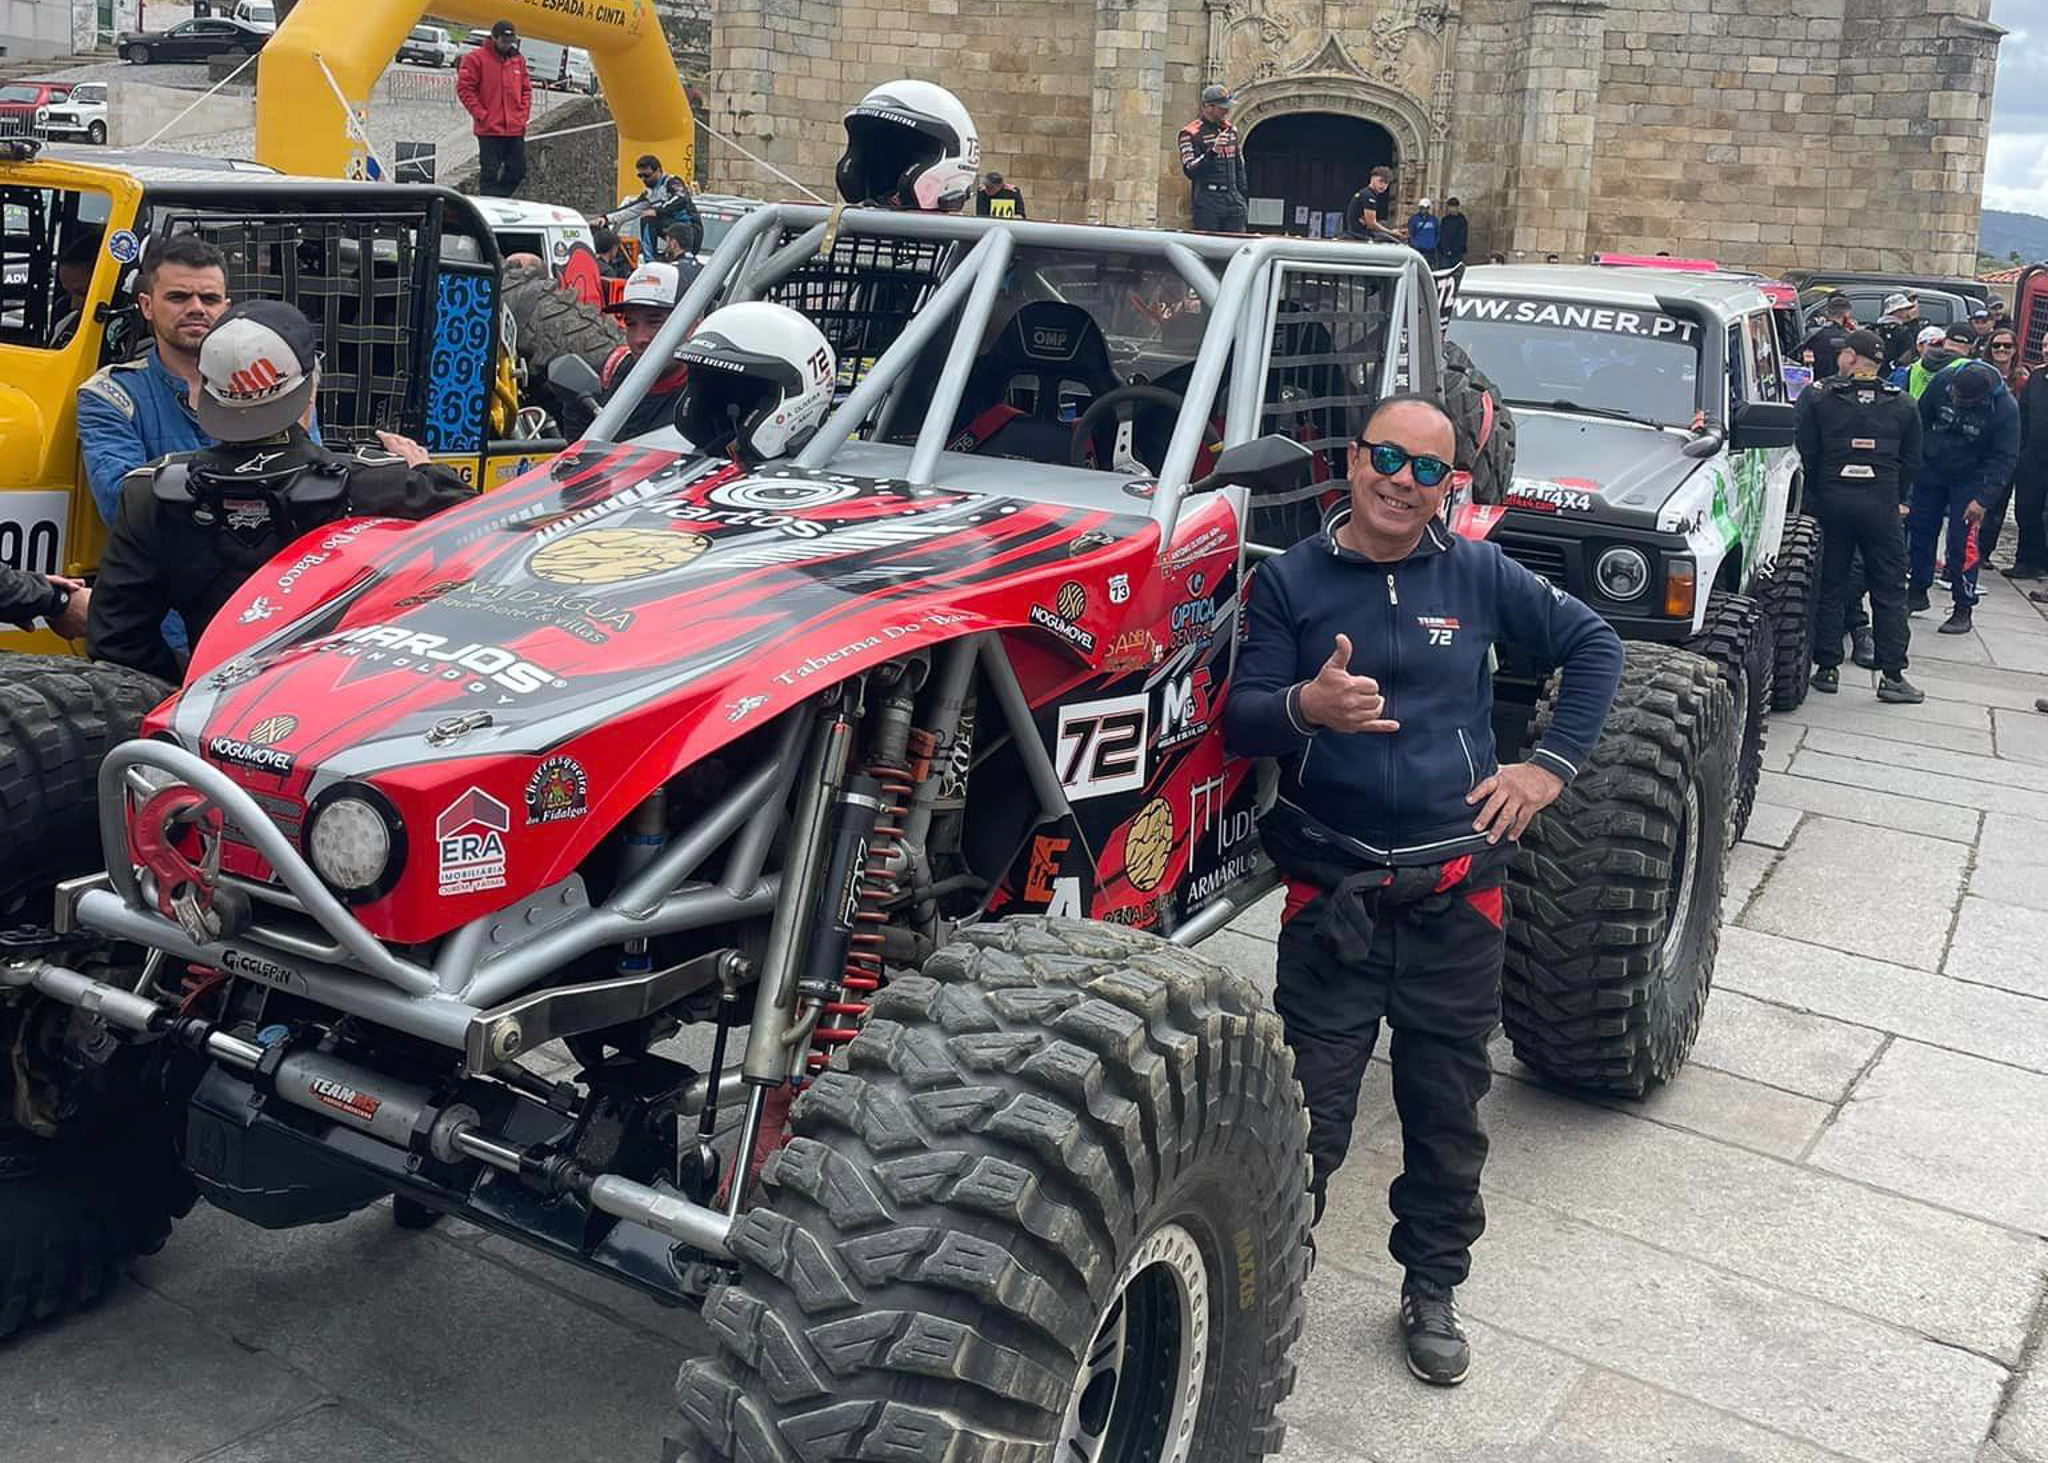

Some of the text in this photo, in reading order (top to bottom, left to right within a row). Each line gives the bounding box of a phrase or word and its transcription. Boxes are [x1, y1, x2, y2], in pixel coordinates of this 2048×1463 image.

[595, 6, 627, 27] CINTA
[1451, 297, 1700, 343] WW.SANER.PT
[1033, 331, 1067, 346] OMP
[807, 347, 831, 379] 72
[1112, 585, 1129, 601] 73
[555, 617, 608, 643] villas
[1031, 605, 1093, 650] NOGUMOVEL
[1429, 629, 1453, 645] 72
[772, 634, 882, 687] Taberna
[210, 739, 290, 769] NOGUMOVEL
[1062, 708, 1146, 788] 72
[525, 756, 588, 805] Churrasqueira
[542, 805, 588, 822] Fidalgos
[442, 833, 502, 864] ERA
[222, 950, 291, 985] GIGGLEPIN
